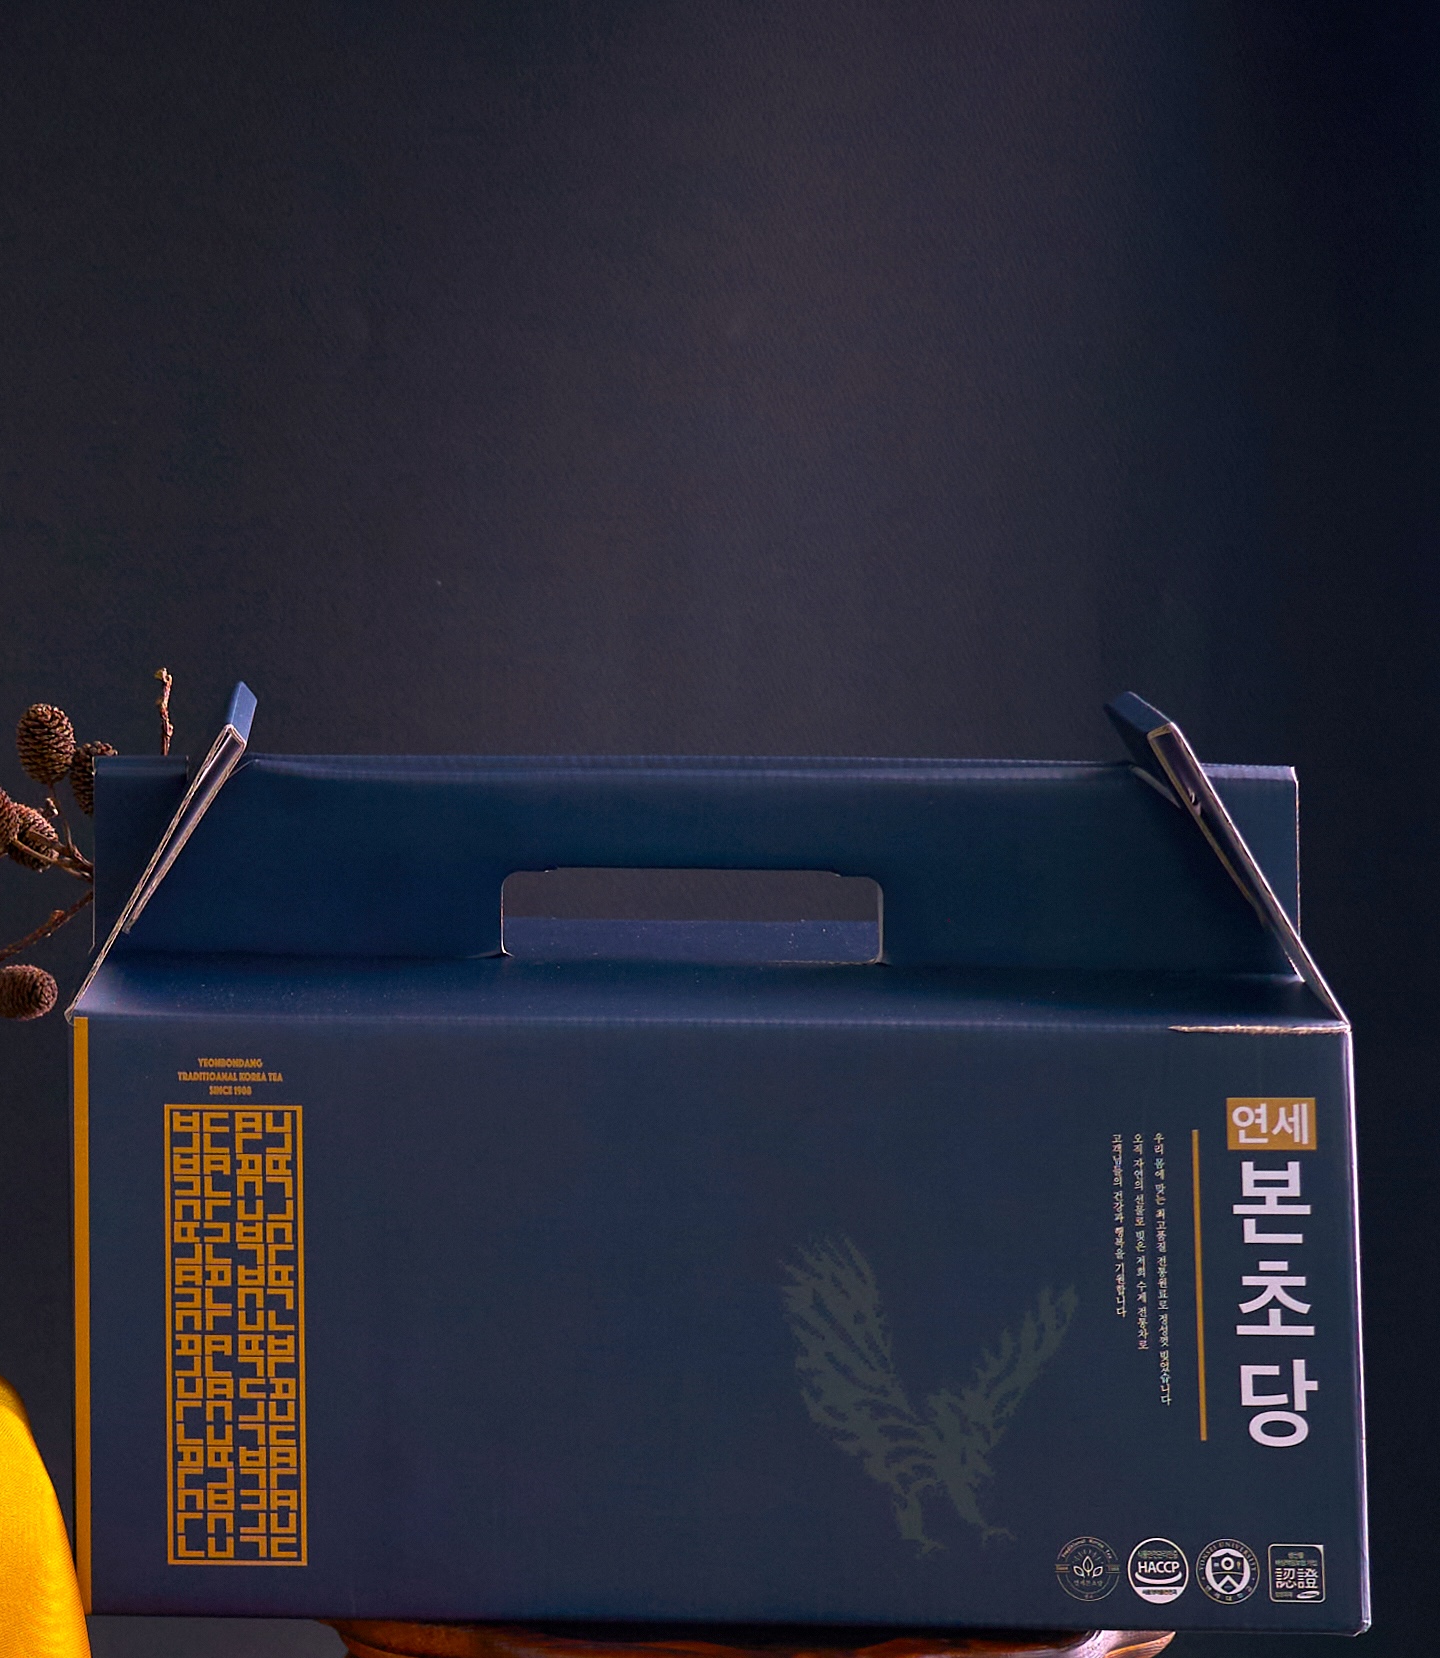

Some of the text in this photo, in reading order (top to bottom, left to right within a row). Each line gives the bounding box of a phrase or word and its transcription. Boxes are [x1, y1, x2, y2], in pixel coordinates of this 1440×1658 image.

[239, 1072, 267, 1082] KOREA
[268, 1072, 283, 1082] TEA
[1232, 1103, 1310, 1145] 연세
[1133, 1133, 1143, 1155] 오직
[1153, 1132, 1165, 1155] 우리
[1133, 1157, 1145, 1191] 자연의
[1155, 1183, 1166, 1206] 맞는
[1135, 1230, 1147, 1253] 빚은
[1136, 1280, 1148, 1303] 수제
[1232, 1161, 1318, 1448] 본초당
[1137, 1561, 1180, 1573] HACCP
[1274, 1567, 1319, 1589] 認證
